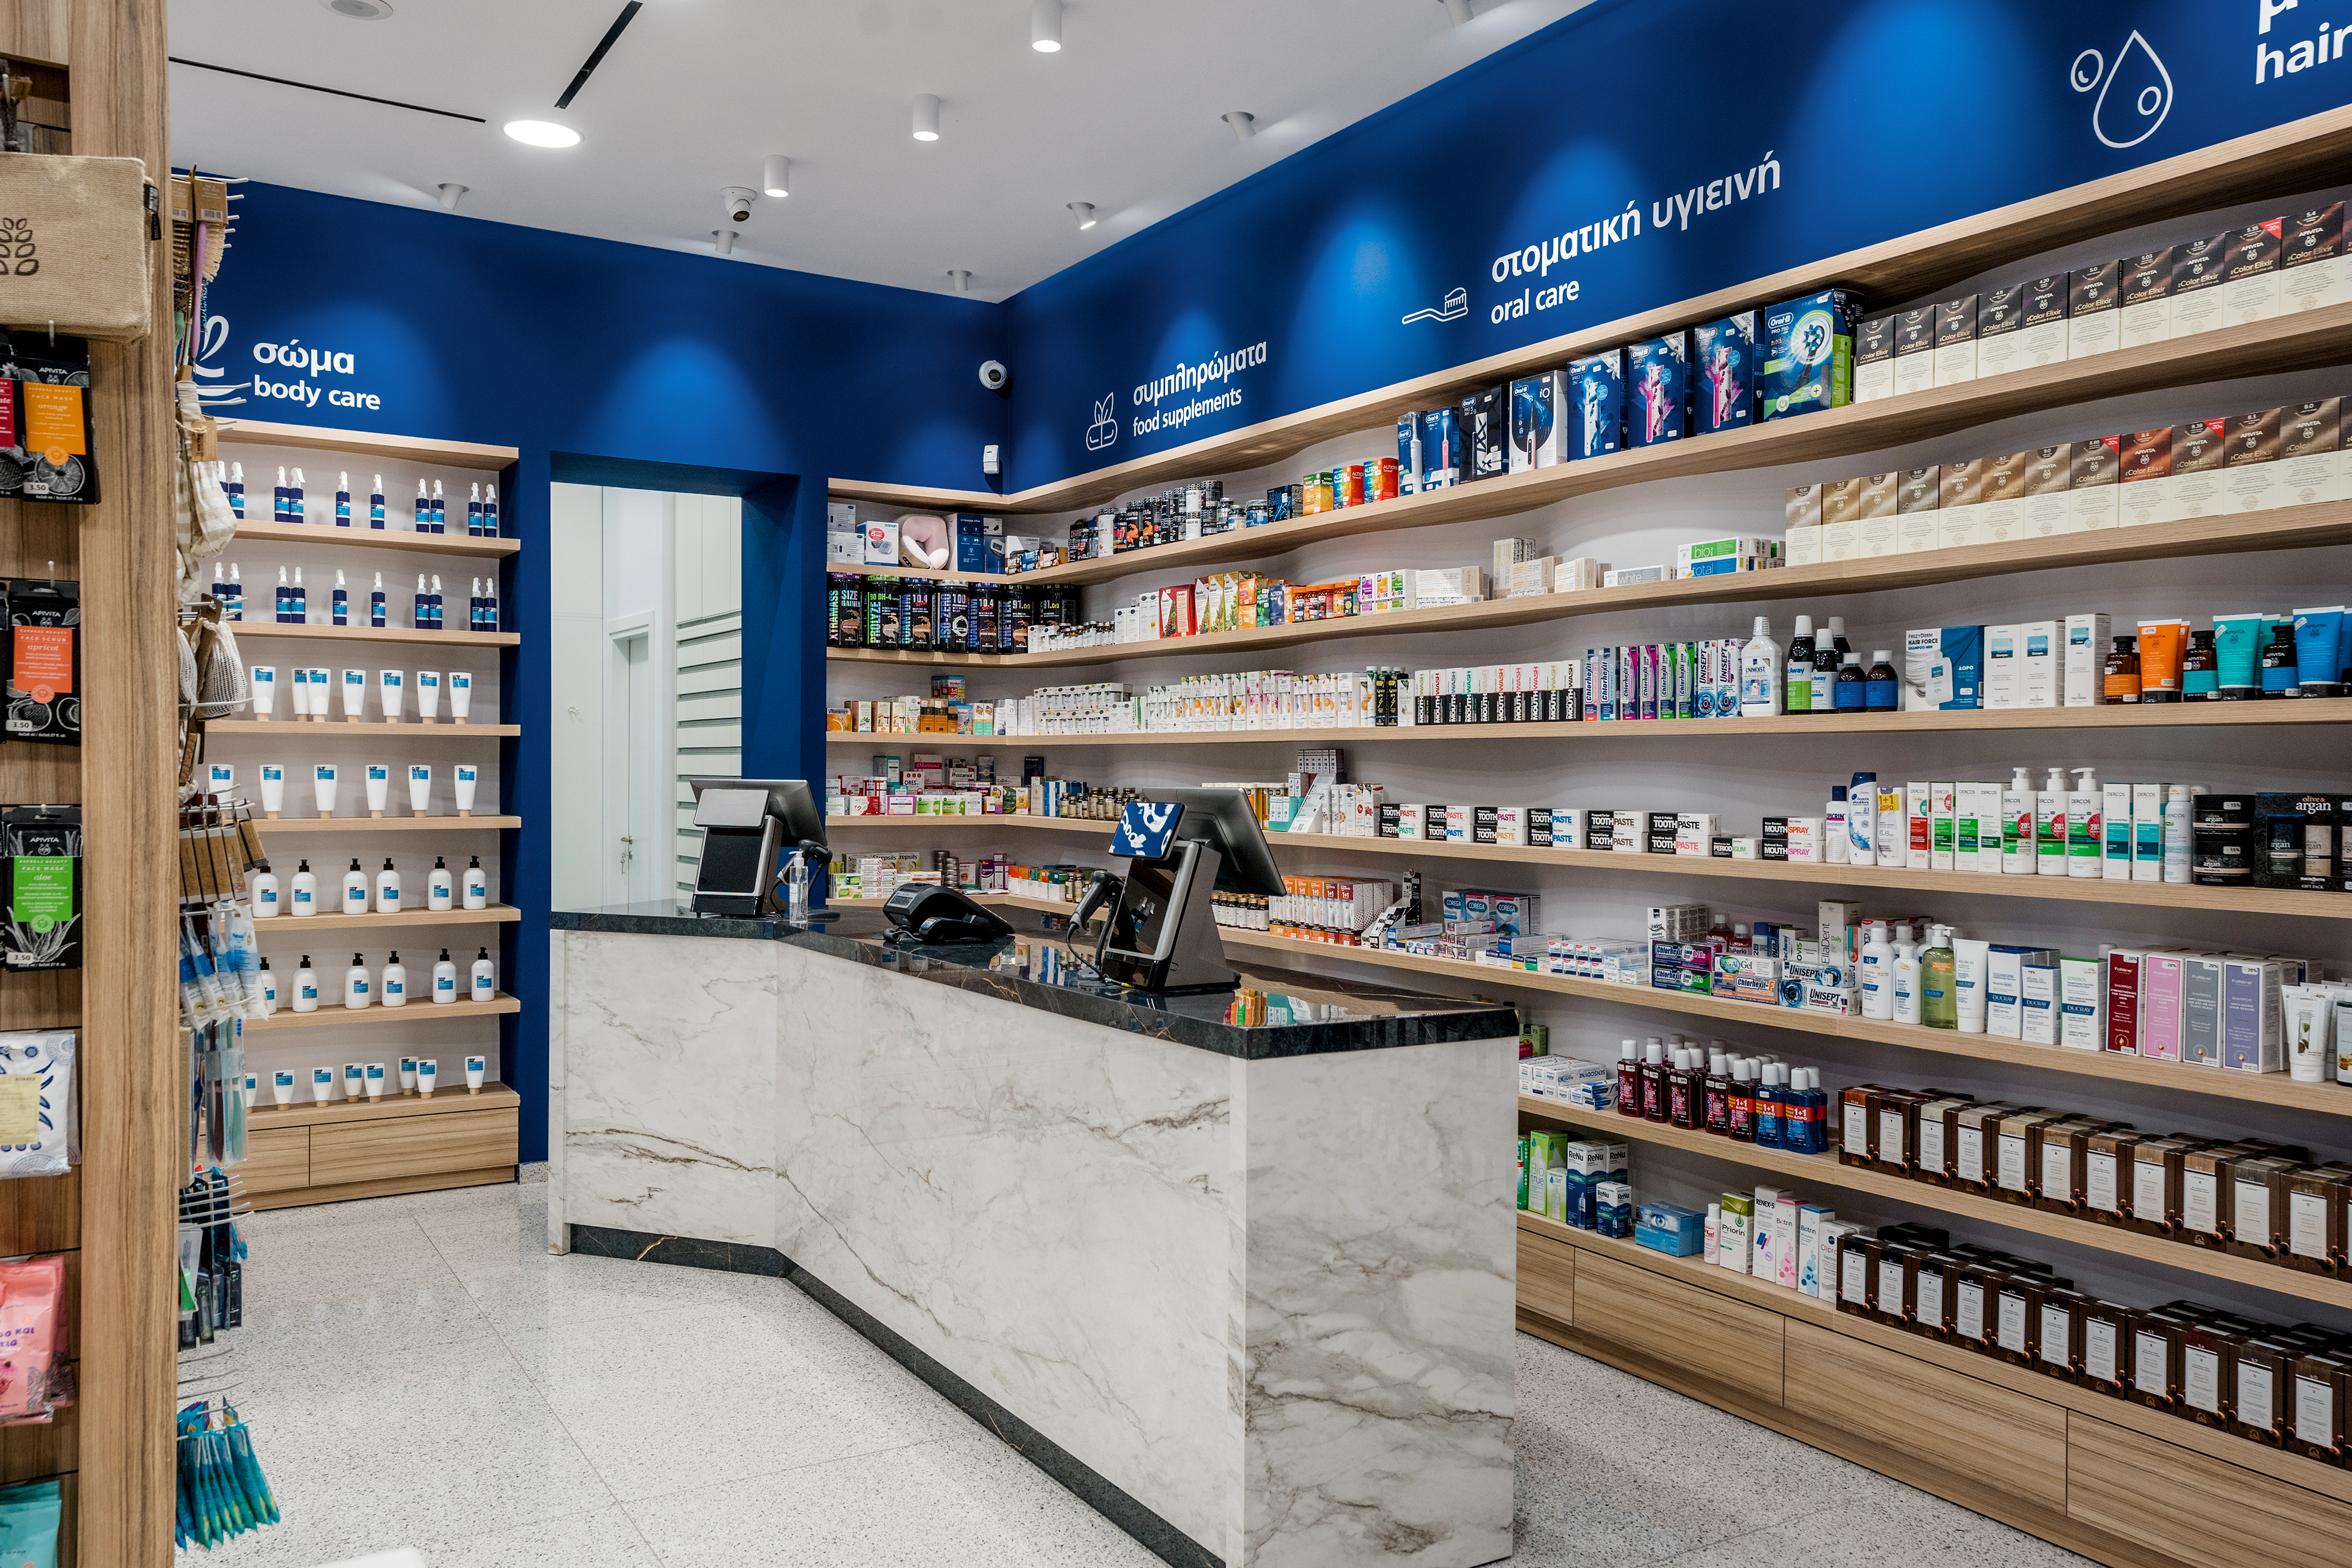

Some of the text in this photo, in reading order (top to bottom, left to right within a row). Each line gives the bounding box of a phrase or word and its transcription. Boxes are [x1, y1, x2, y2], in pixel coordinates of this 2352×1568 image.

[1492, 150, 1780, 283] στοματική υγιεινή
[2290, 245, 2333, 260] Color Elixir
[2234, 259, 2273, 274] Color Elixir
[2181, 273, 2219, 287] Color Elixir
[1491, 280, 1580, 324] oral care
[1770, 314, 1791, 327] Oral-B
[253, 339, 354, 377] σώμα
[1133, 341, 1267, 406] συμπληρώματα
[254, 375, 381, 410] body care
[1514, 386, 1528, 395] Oral-B
[38, 404, 68, 412] orange
[1463, 398, 1475, 407] Oral-B
[1133, 388, 1242, 437] food supplements
[1427, 414, 1440, 423] Oral-B
[1694, 545, 1710, 559] bio
[1692, 564, 1713, 576] total
[1618, 572, 1642, 584] white
[842, 590, 858, 600] SIZE
[912, 594, 928, 603] 10.4
[829, 590, 838, 640] XTRAMASS
[870, 601, 881, 644] PROLYZE
[2296, 802, 2332, 814] argan
[1765, 825, 1787, 833] MOUTH
[1764, 846, 1788, 855] MOUTH
[1468, 902, 1485, 910] COREGA
[1498, 904, 1516, 912] COREGA
[1822, 923, 1830, 964] EllaDent
[1657, 945, 1682, 957] Chlorhexil
[1741, 961, 1752, 969] Gel
[1657, 969, 1682, 980] Chlorhexil
[1790, 965, 1819, 978] UNISEPT
[1810, 988, 1841, 1002] UNISEPT
[1736, 1098, 1747, 1107] 1+1
[1569, 1150, 1584, 1161] ReNu
[1587, 1152, 1603, 1162] ReNu
[1610, 1151, 1626, 1160] ReNu
[1531, 1163, 1544, 1176] Bio
[1531, 1174, 1544, 1185] true
[1597, 1190, 1609, 1198] ReNu
[1776, 1218, 1793, 1226] Biotrin
[1722, 1224, 1745, 1237] Priorin
[1801, 1225, 1816, 1235] Biotrin
